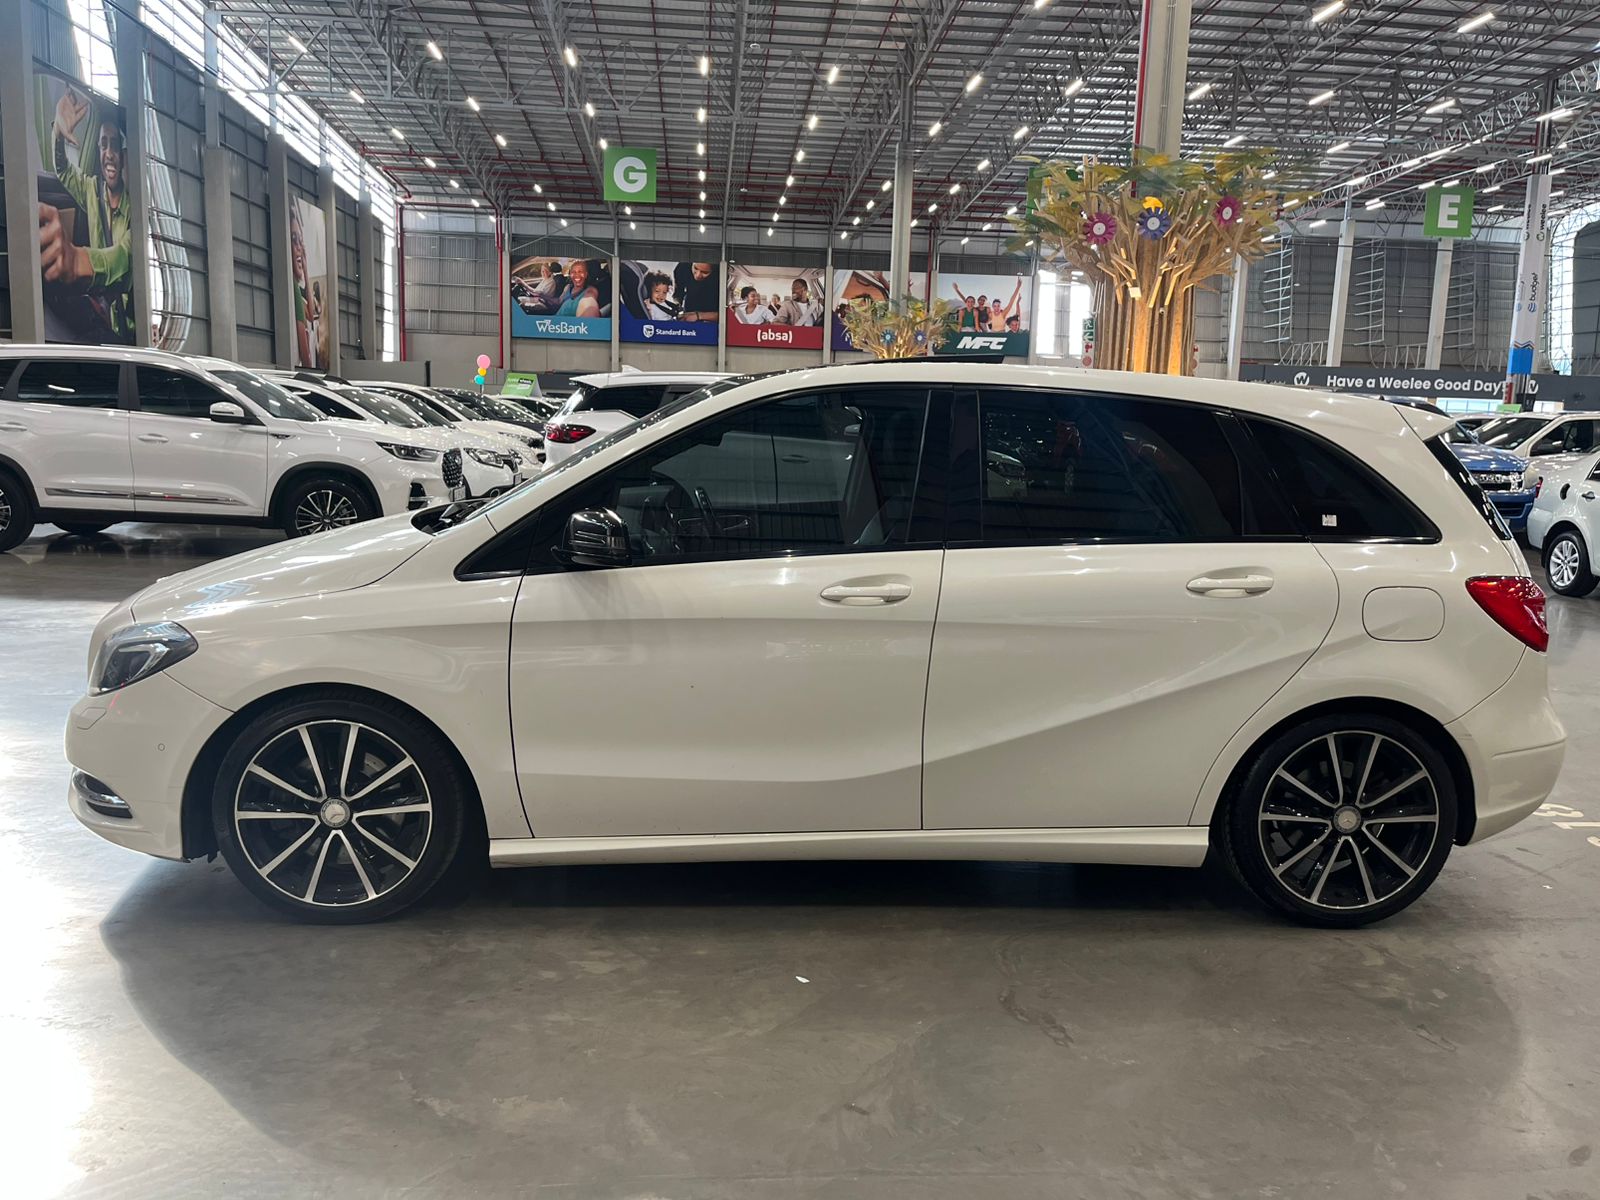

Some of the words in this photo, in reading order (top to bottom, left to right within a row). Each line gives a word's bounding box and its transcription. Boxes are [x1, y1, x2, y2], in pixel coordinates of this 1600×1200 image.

[613, 156, 648, 193] G
[1437, 194, 1461, 229] E
[1529, 272, 1540, 302] budget
[535, 319, 588, 335] WesBank
[655, 328, 681, 336] Standard
[682, 329, 697, 337] Bank
[956, 336, 1008, 350] MFC
[1326, 375, 1363, 388] Have
[1366, 378, 1376, 388] a
[1379, 377, 1431, 389] Weelee
[1434, 379, 1471, 391] Good
